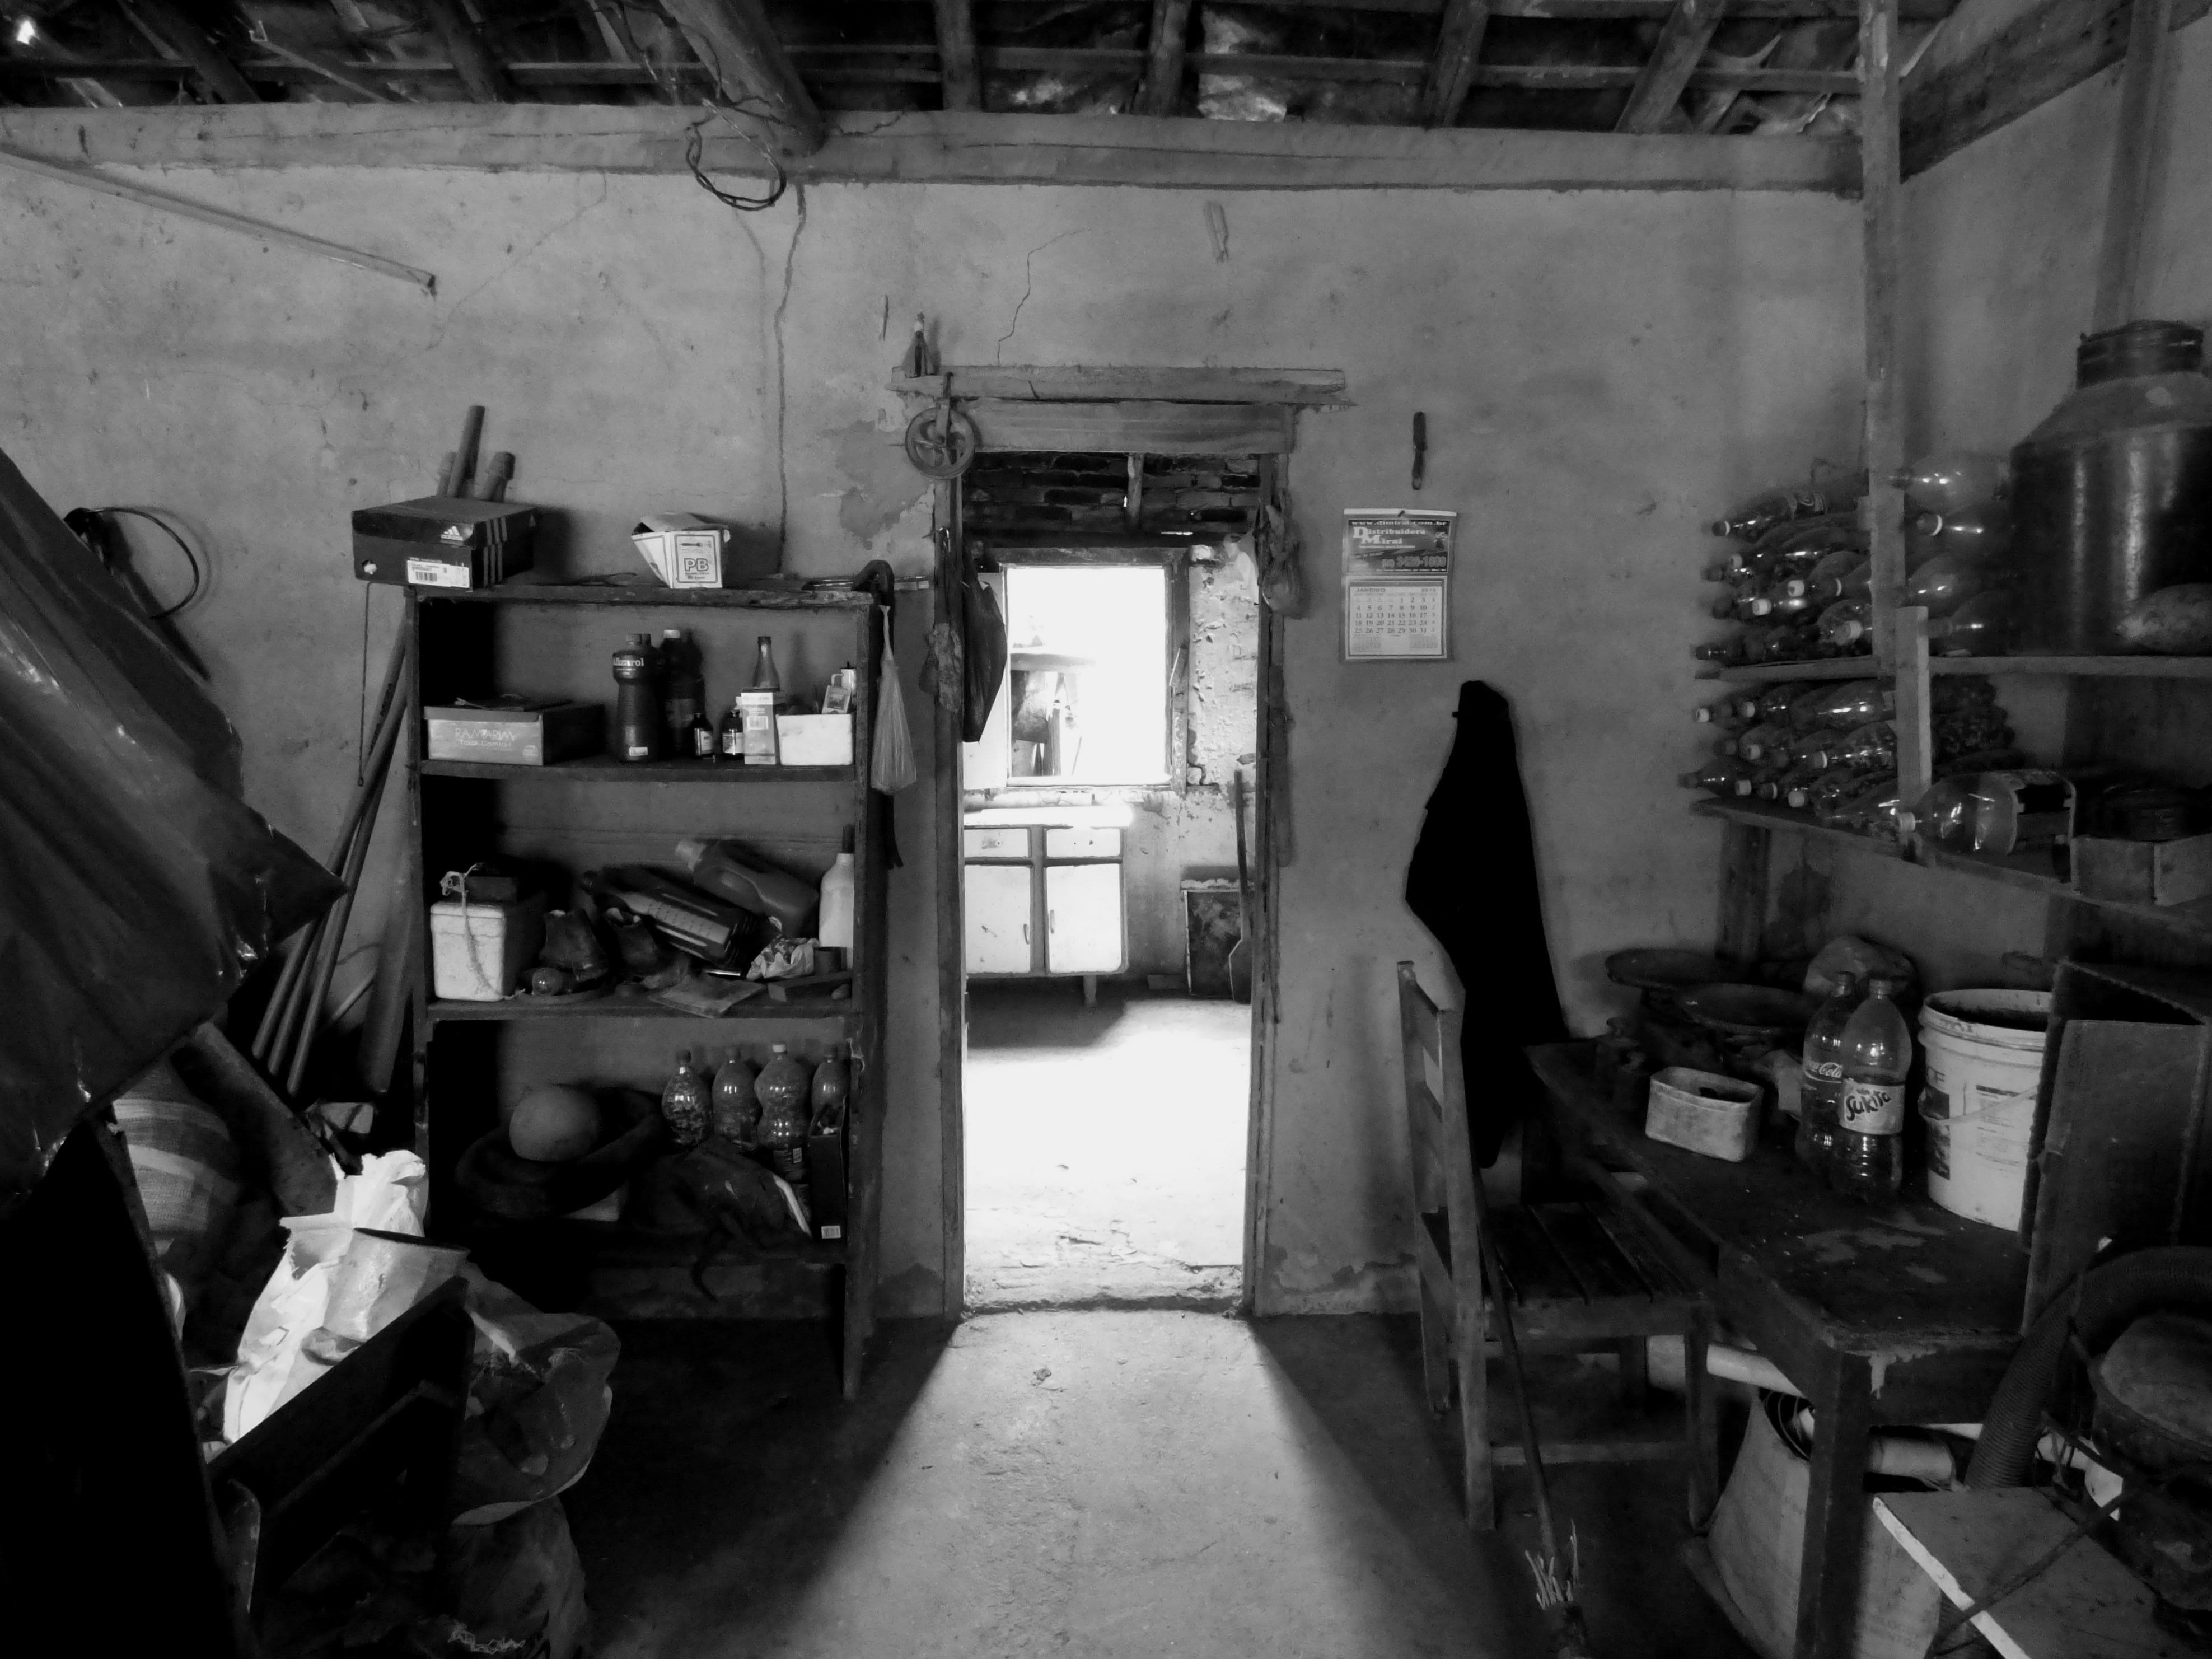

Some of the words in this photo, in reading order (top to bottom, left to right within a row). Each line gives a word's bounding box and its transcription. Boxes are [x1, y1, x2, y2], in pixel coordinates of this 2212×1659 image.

[1352, 526, 1426, 538] Distribuidora
[684, 558, 709, 572] PB
[1846, 1091, 1891, 1121] Sukita
